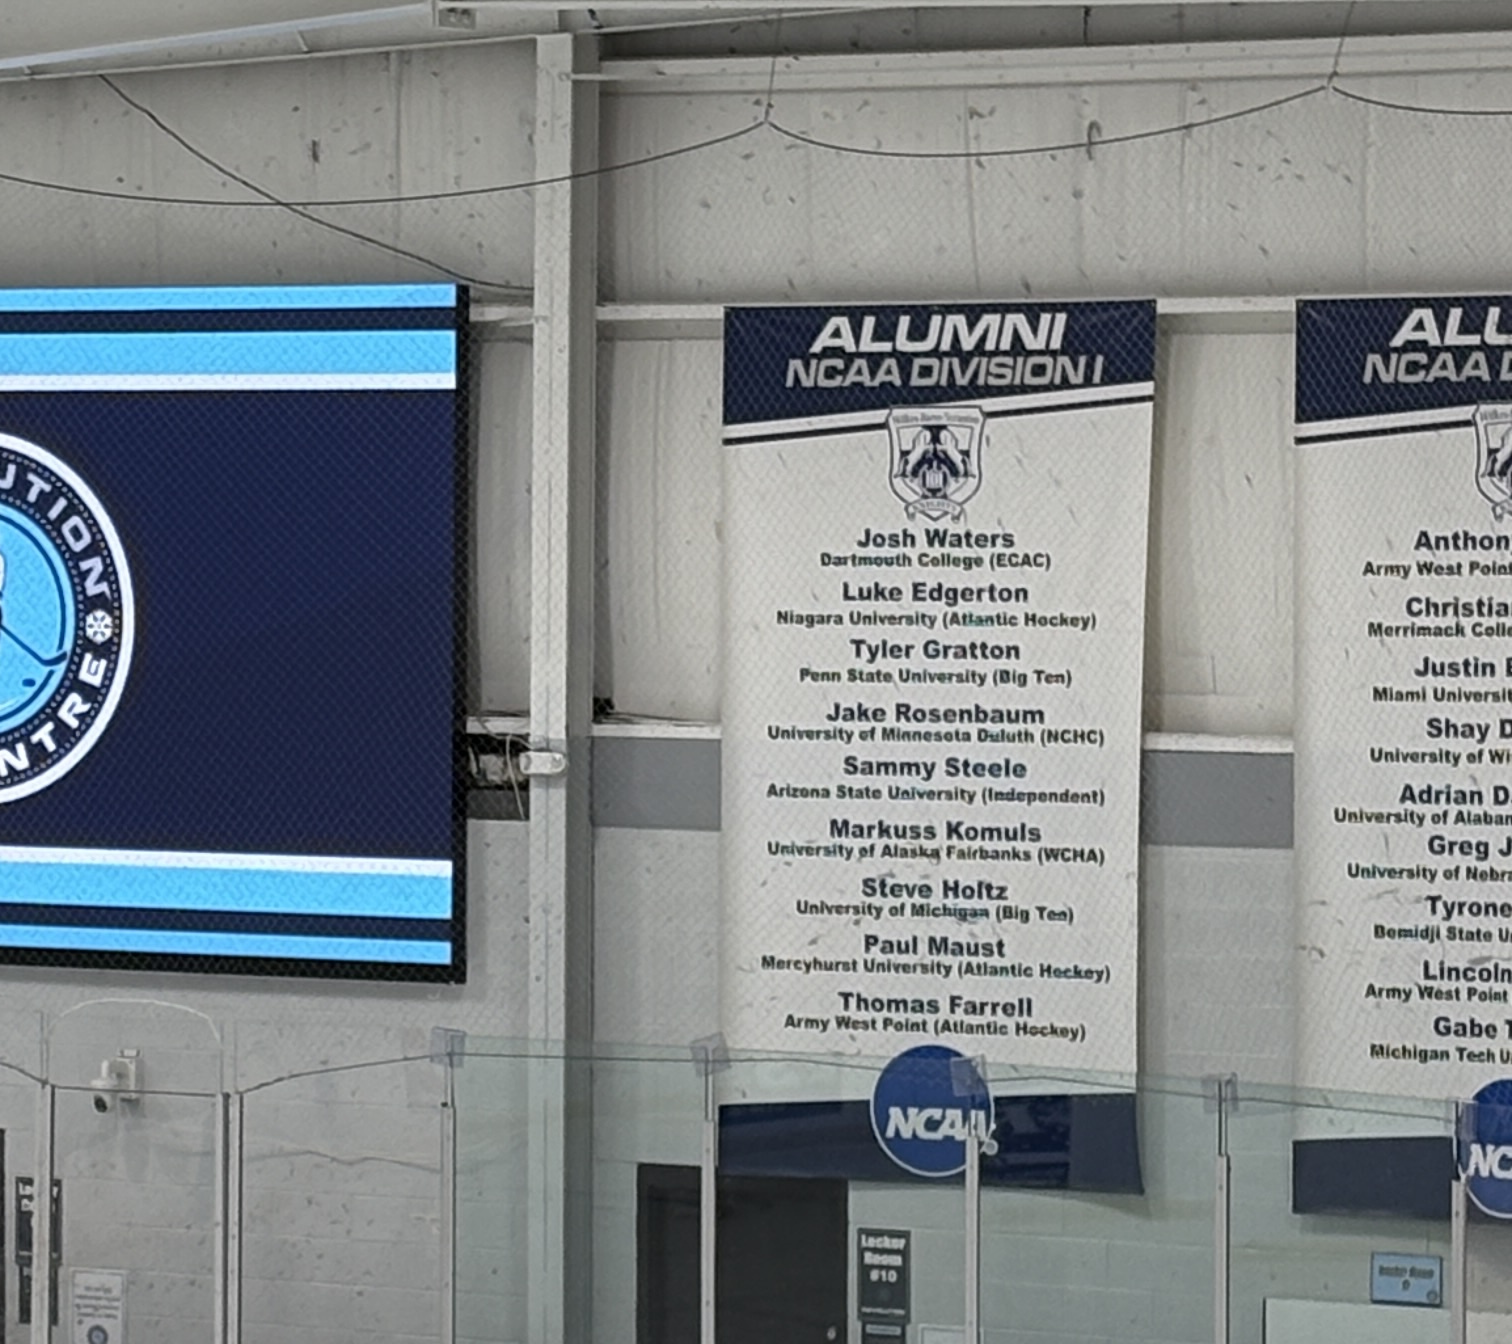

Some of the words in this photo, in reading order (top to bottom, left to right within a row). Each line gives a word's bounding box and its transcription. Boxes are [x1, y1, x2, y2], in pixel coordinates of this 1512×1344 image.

[809, 312, 1067, 353] ALUMNI
[786, 357, 901, 389] NCAA
[910, 355, 1084, 387] DIVISION
[1092, 355, 1104, 385] I
[1363, 352, 1491, 384] NCAA
[857, 528, 916, 549] Josh
[924, 528, 1015, 549] Waters
[1414, 530, 1512, 552] Anthon
[820, 554, 912, 568] Dartmouth
[918, 554, 984, 571] College
[989, 554, 1052, 571] (ECAC)
[1362, 561, 1411, 580] Army
[1416, 561, 1462, 577] West
[842, 582, 903, 603] Luke
[912, 583, 1029, 606] Edgerton
[1406, 596, 1512, 618] Christia
[777, 611, 844, 630] Niagara
[849, 611, 937, 630] University
[943, 611, 1019, 630] (Atlantic
[1024, 612, 1097, 632] Hockey)
[850, 639, 915, 664] Tyler
[922, 641, 1020, 660] Gratton
[799, 668, 841, 684] Penn
[847, 669, 893, 684] State
[898, 669, 986, 687] University
[993, 669, 1028, 687] (Big
[1033, 670, 1072, 687] Ten)
[1414, 657, 1496, 677] Justin
[826, 702, 887, 722] Jake
[895, 704, 1045, 725] Rosenbaum
[768, 726, 855, 744] University
[859, 727, 876, 743] of
[881, 727, 971, 743] Minnesota
[977, 728, 1034, 744] Duluth
[1040, 729, 1104, 747] (NCHC)
[1426, 718, 1490, 744] Shay
[842, 756, 936, 780] Sammy
[945, 758, 1027, 778] Steele
[766, 784, 830, 799] Arizona
[836, 785, 882, 800] State
[888, 785, 976, 804] University
[982, 788, 1105, 807] (Independent)
[1399, 784, 1483, 805] Adrian
[829, 819, 937, 840] Markuss
[946, 821, 1041, 842] Komuls
[768, 842, 855, 861] University
[859, 843, 876, 858] of
[880, 844, 940, 860] Alaska
[945, 845, 1032, 862] Fairbanks
[1037, 846, 1105, 866] (WCHA)
[1428, 835, 1489, 861] Greg
[861, 878, 933, 898] Steve
[942, 879, 1009, 901] Holtz
[796, 900, 884, 919] University
[888, 901, 906, 917] of
[910, 902, 990, 921] Michigan
[995, 904, 1030, 923] (Big
[1036, 906, 1074, 924] Ten)
[1426, 895, 1512, 921] Tyrone
[864, 934, 918, 955] Paul
[928, 936, 1005, 958] Maust
[761, 956, 858, 974] Mercyhurst
[863, 959, 953, 979] University
[958, 962, 1033, 979] (Atlantic
[1039, 964, 1110, 984] Hockey)
[1422, 960, 1512, 983] Lincoln
[837, 992, 940, 1015] Thomas
[949, 995, 1033, 1017] Farrell
[784, 1015, 830, 1033] Army
[835, 1016, 877, 1032] West
[883, 1017, 928, 1034] Point
[934, 1019, 1009, 1037] (Atlantic
[1015, 1022, 1086, 1042] Hockey)
[1433, 1016, 1498, 1039] Gabe
[885, 1107, 989, 1141] NCAA
